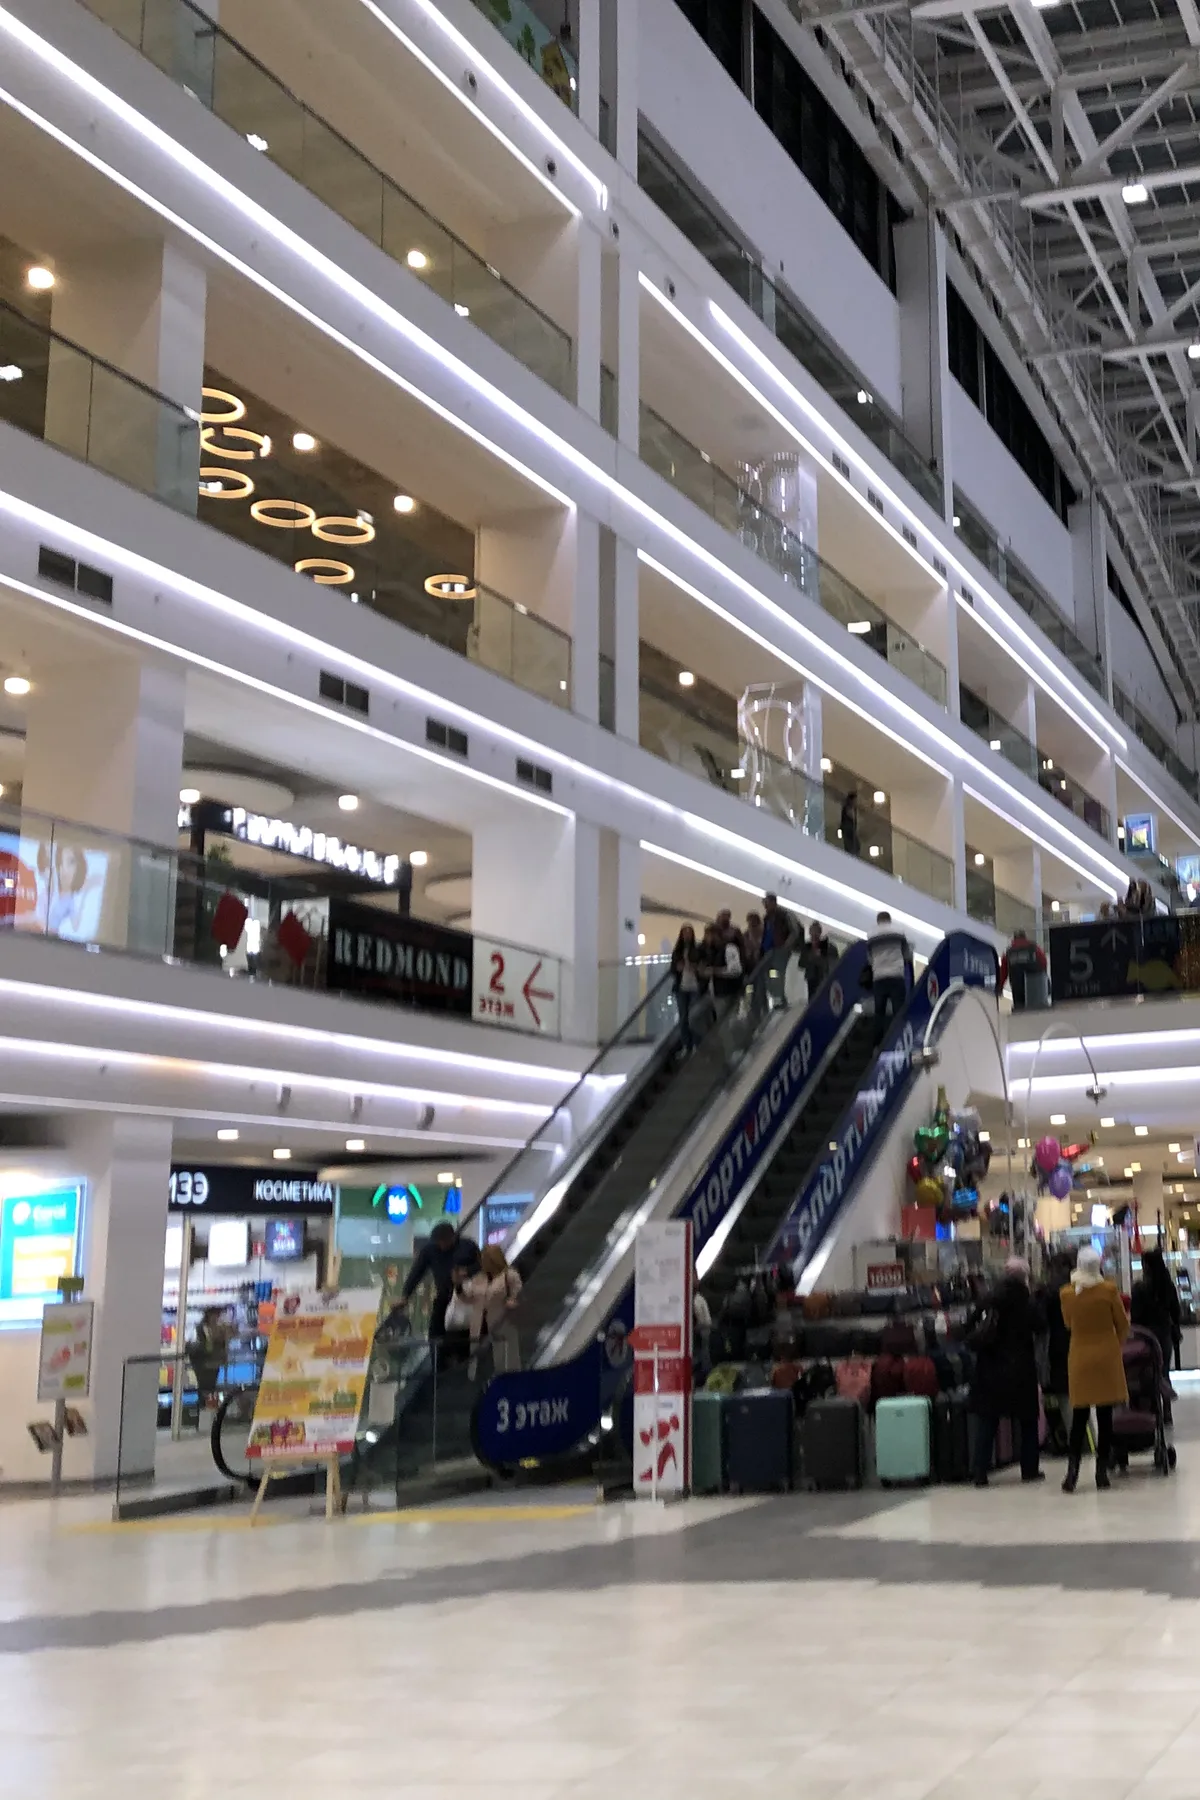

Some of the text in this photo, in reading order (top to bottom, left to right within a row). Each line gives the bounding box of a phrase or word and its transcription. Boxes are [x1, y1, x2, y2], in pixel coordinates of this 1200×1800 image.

[335, 928, 469, 989] REDMOND
[489, 951, 506, 994] 2
[1068, 939, 1094, 982] 5
[255, 1179, 333, 1202] КОСМЕТИКА
[496, 1397, 569, 1434] 3 этаж
